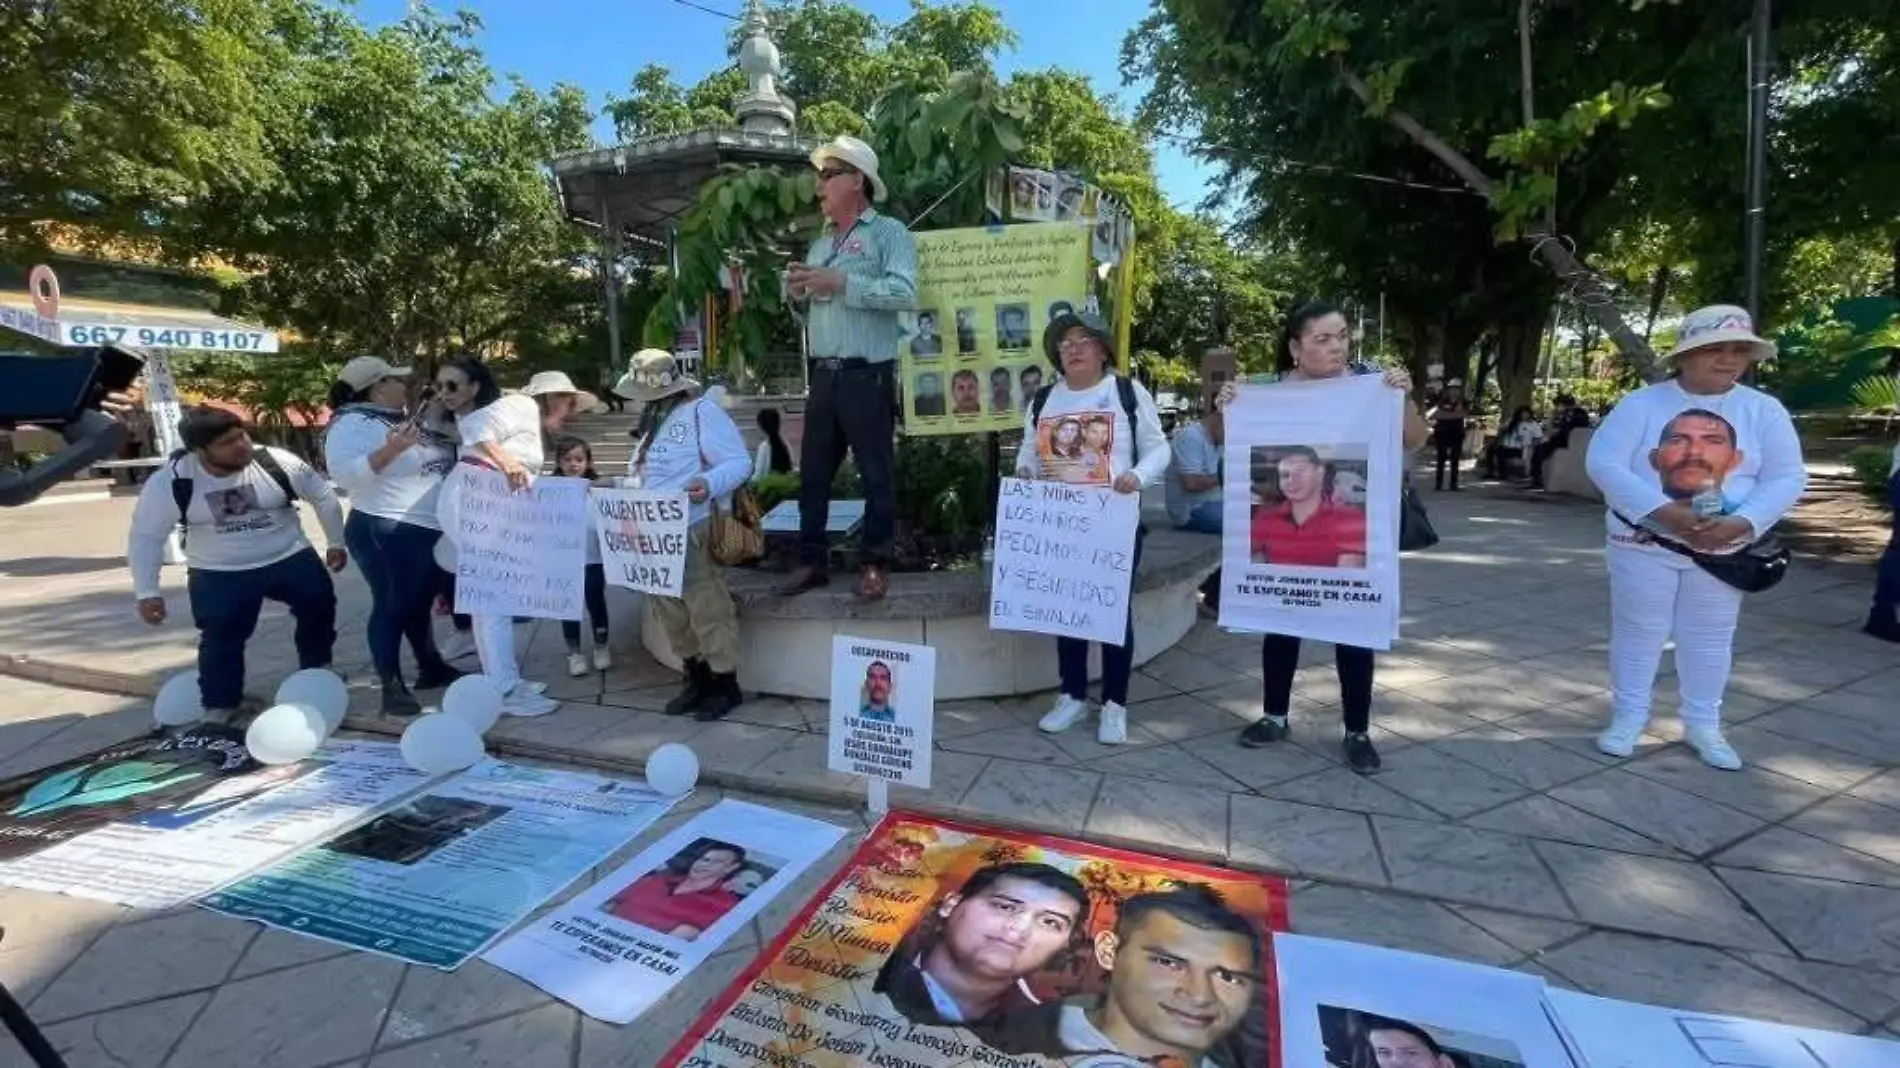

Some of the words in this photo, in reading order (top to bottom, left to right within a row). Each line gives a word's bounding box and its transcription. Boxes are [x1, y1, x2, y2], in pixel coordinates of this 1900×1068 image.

[70, 325, 128, 345] 667
[139, 328, 191, 347] 940
[201, 331, 263, 349] 8107
[1003, 480, 1033, 499] LAS
[1098, 492, 1111, 511] Y
[596, 497, 657, 523] VALIENTE
[657, 499, 684, 522] ES
[1005, 504, 1034, 523] LOS
[638, 532, 684, 556] ELIGE
[1000, 529, 1083, 561] PEDIMOS
[1092, 549, 1128, 572] PAZ
[623, 562, 641, 583] LA
[641, 565, 673, 588] PAZ
[999, 564, 1009, 580] Y
[1016, 569, 1117, 607] SEGURIDAD
[1237, 584, 1250, 594] TE
[1254, 585, 1321, 599] ESPERAMOS
[1324, 590, 1339, 600] EN
[1343, 591, 1382, 603] CASA!
[850, 717, 860, 727] DE
[861, 719, 892, 734] AGOSTO
[639, 956, 680, 976] CASA!
